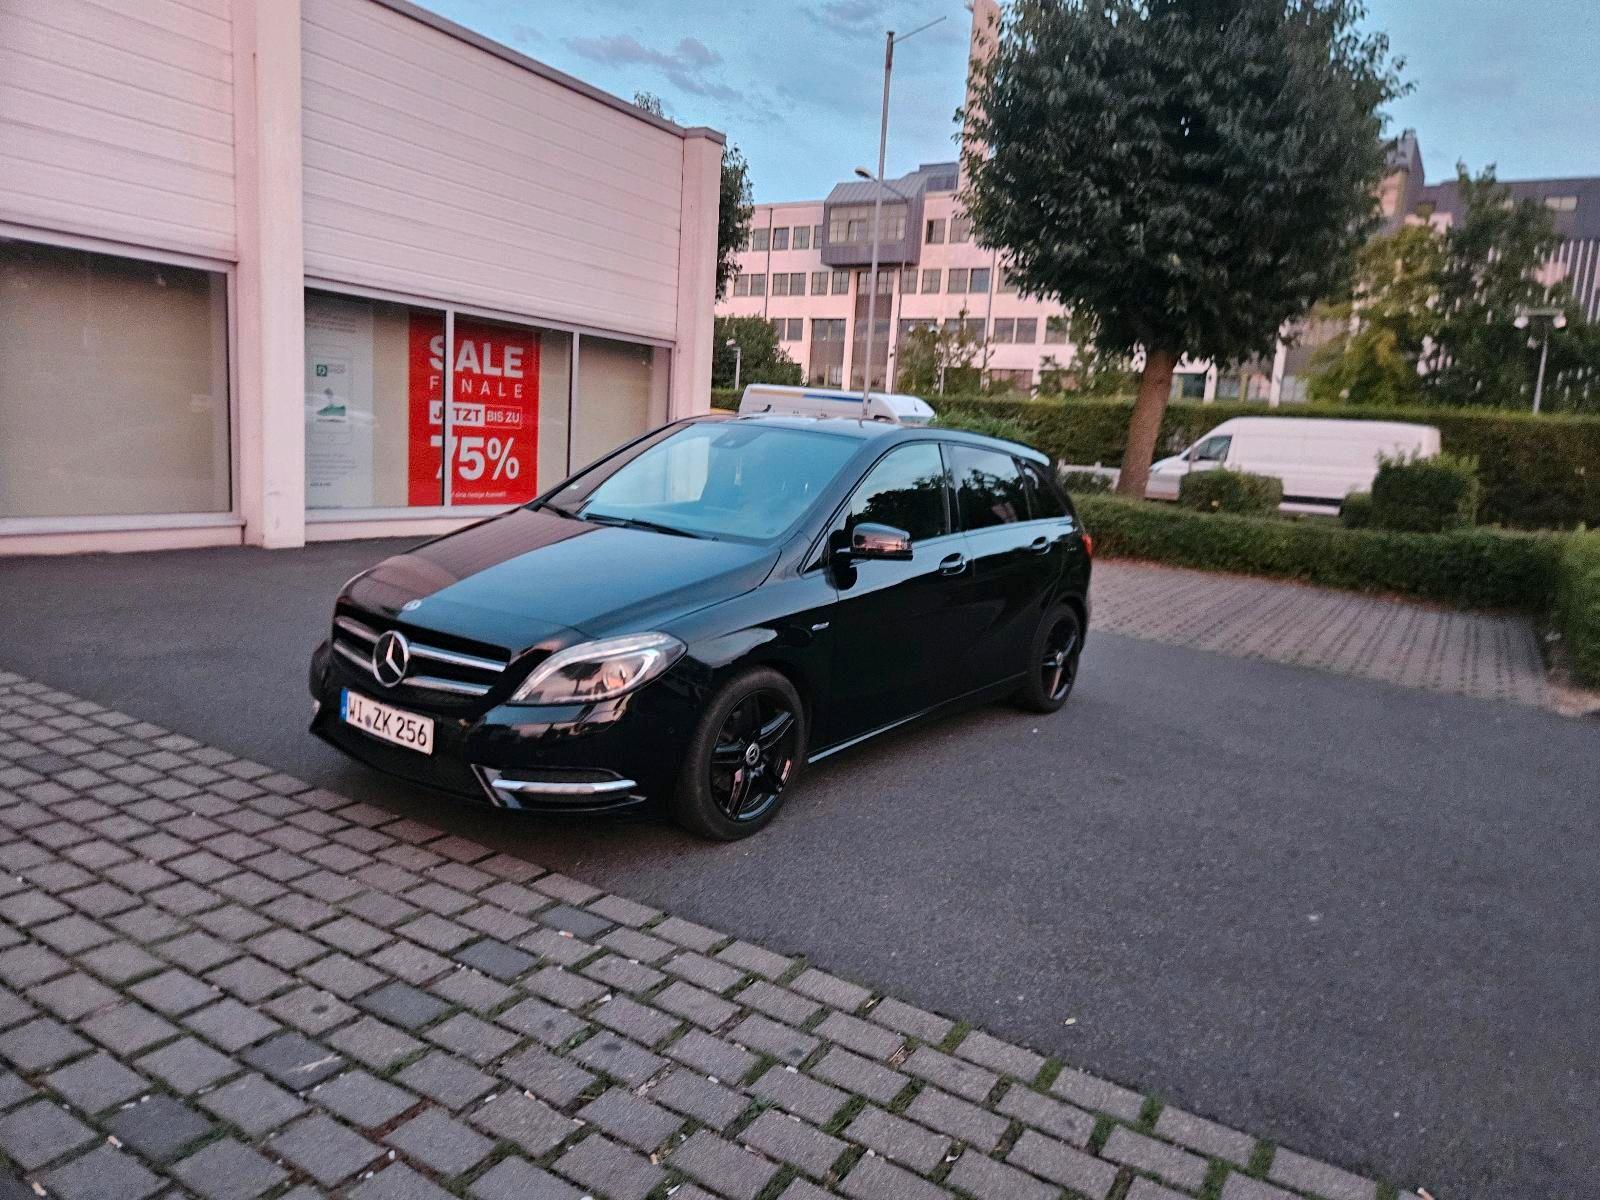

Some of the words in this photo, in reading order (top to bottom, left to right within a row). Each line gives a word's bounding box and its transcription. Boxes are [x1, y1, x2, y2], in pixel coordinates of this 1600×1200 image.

[429, 375, 523, 399] FNALE
[433, 406, 481, 422] JTZT
[486, 410, 504, 422] BIS
[505, 411, 520, 424] ZU
[372, 706, 392, 736] ZK
[395, 716, 427, 747] 256
